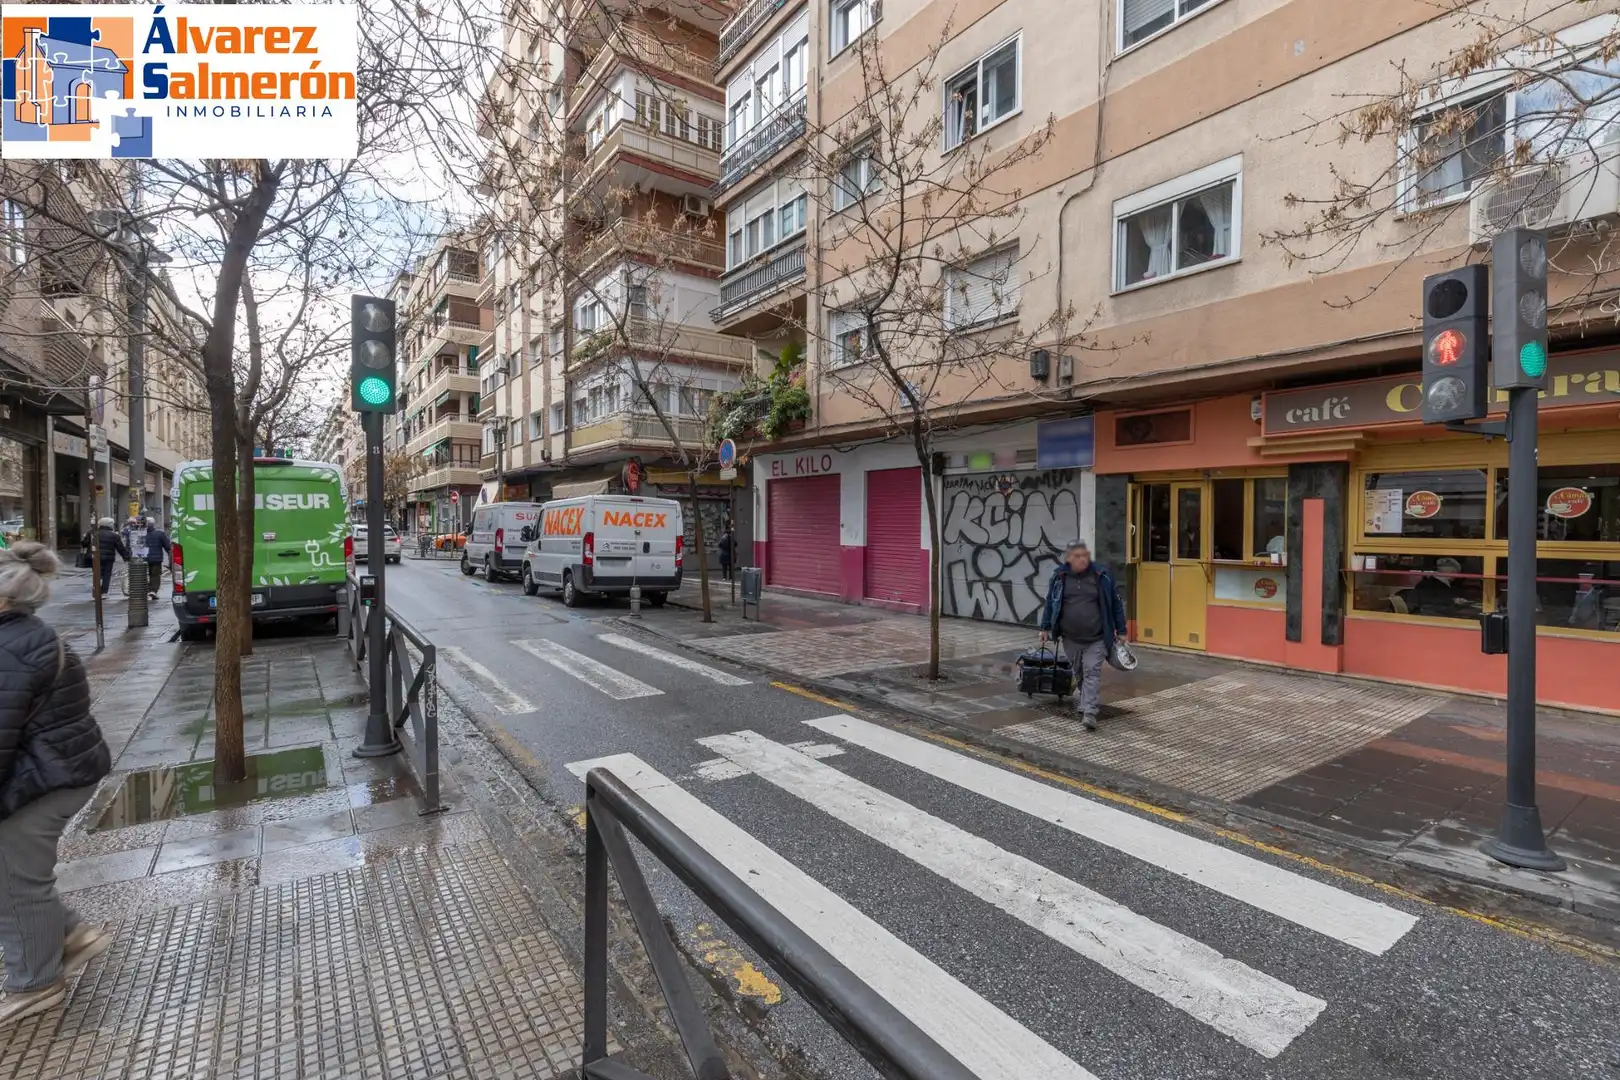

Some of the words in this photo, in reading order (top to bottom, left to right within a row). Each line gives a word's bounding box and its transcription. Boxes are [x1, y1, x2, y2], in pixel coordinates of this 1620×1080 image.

[1285, 396, 1351, 424] café
[772, 459, 788, 477] EL
[795, 454, 832, 475] KILO
[266, 493, 331, 510] SEUR
[543, 507, 586, 536] NACEX
[603, 510, 667, 528] NACEX
